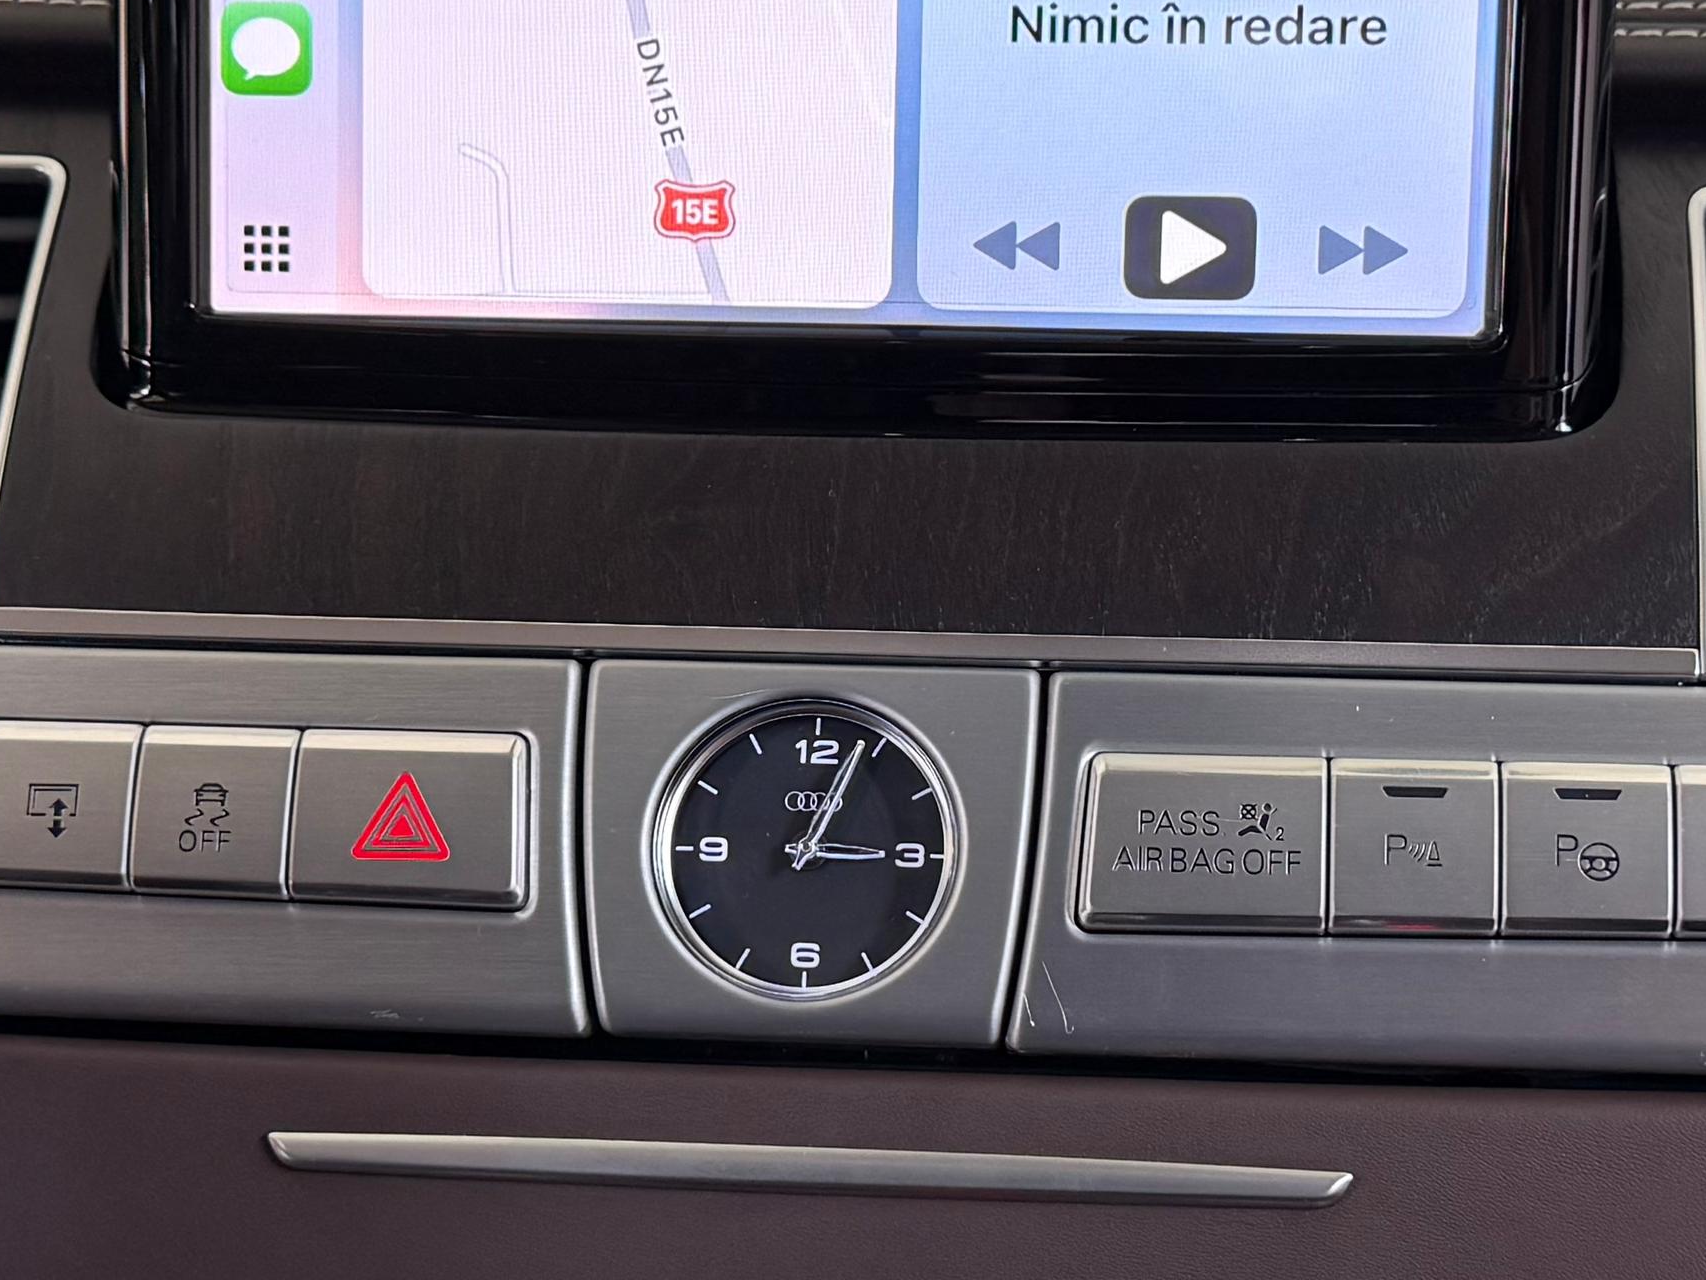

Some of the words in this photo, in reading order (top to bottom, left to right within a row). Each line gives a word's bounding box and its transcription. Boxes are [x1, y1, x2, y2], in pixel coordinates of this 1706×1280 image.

[1009, 4, 1150, 46] Nimic
[1163, 1, 1207, 46] în
[1224, 4, 1389, 46] redare
[636, 38, 685, 147] DN15E
[671, 198, 721, 226] 15E
[795, 739, 839, 765] 12
[178, 829, 232, 854] OFF
[698, 836, 729, 862] 9
[1383, 833, 1408, 867] P
[1554, 834, 1580, 868] P
[894, 843, 926, 869] 3
[1241, 848, 1302, 876] OFF
[790, 942, 821, 969] 6
